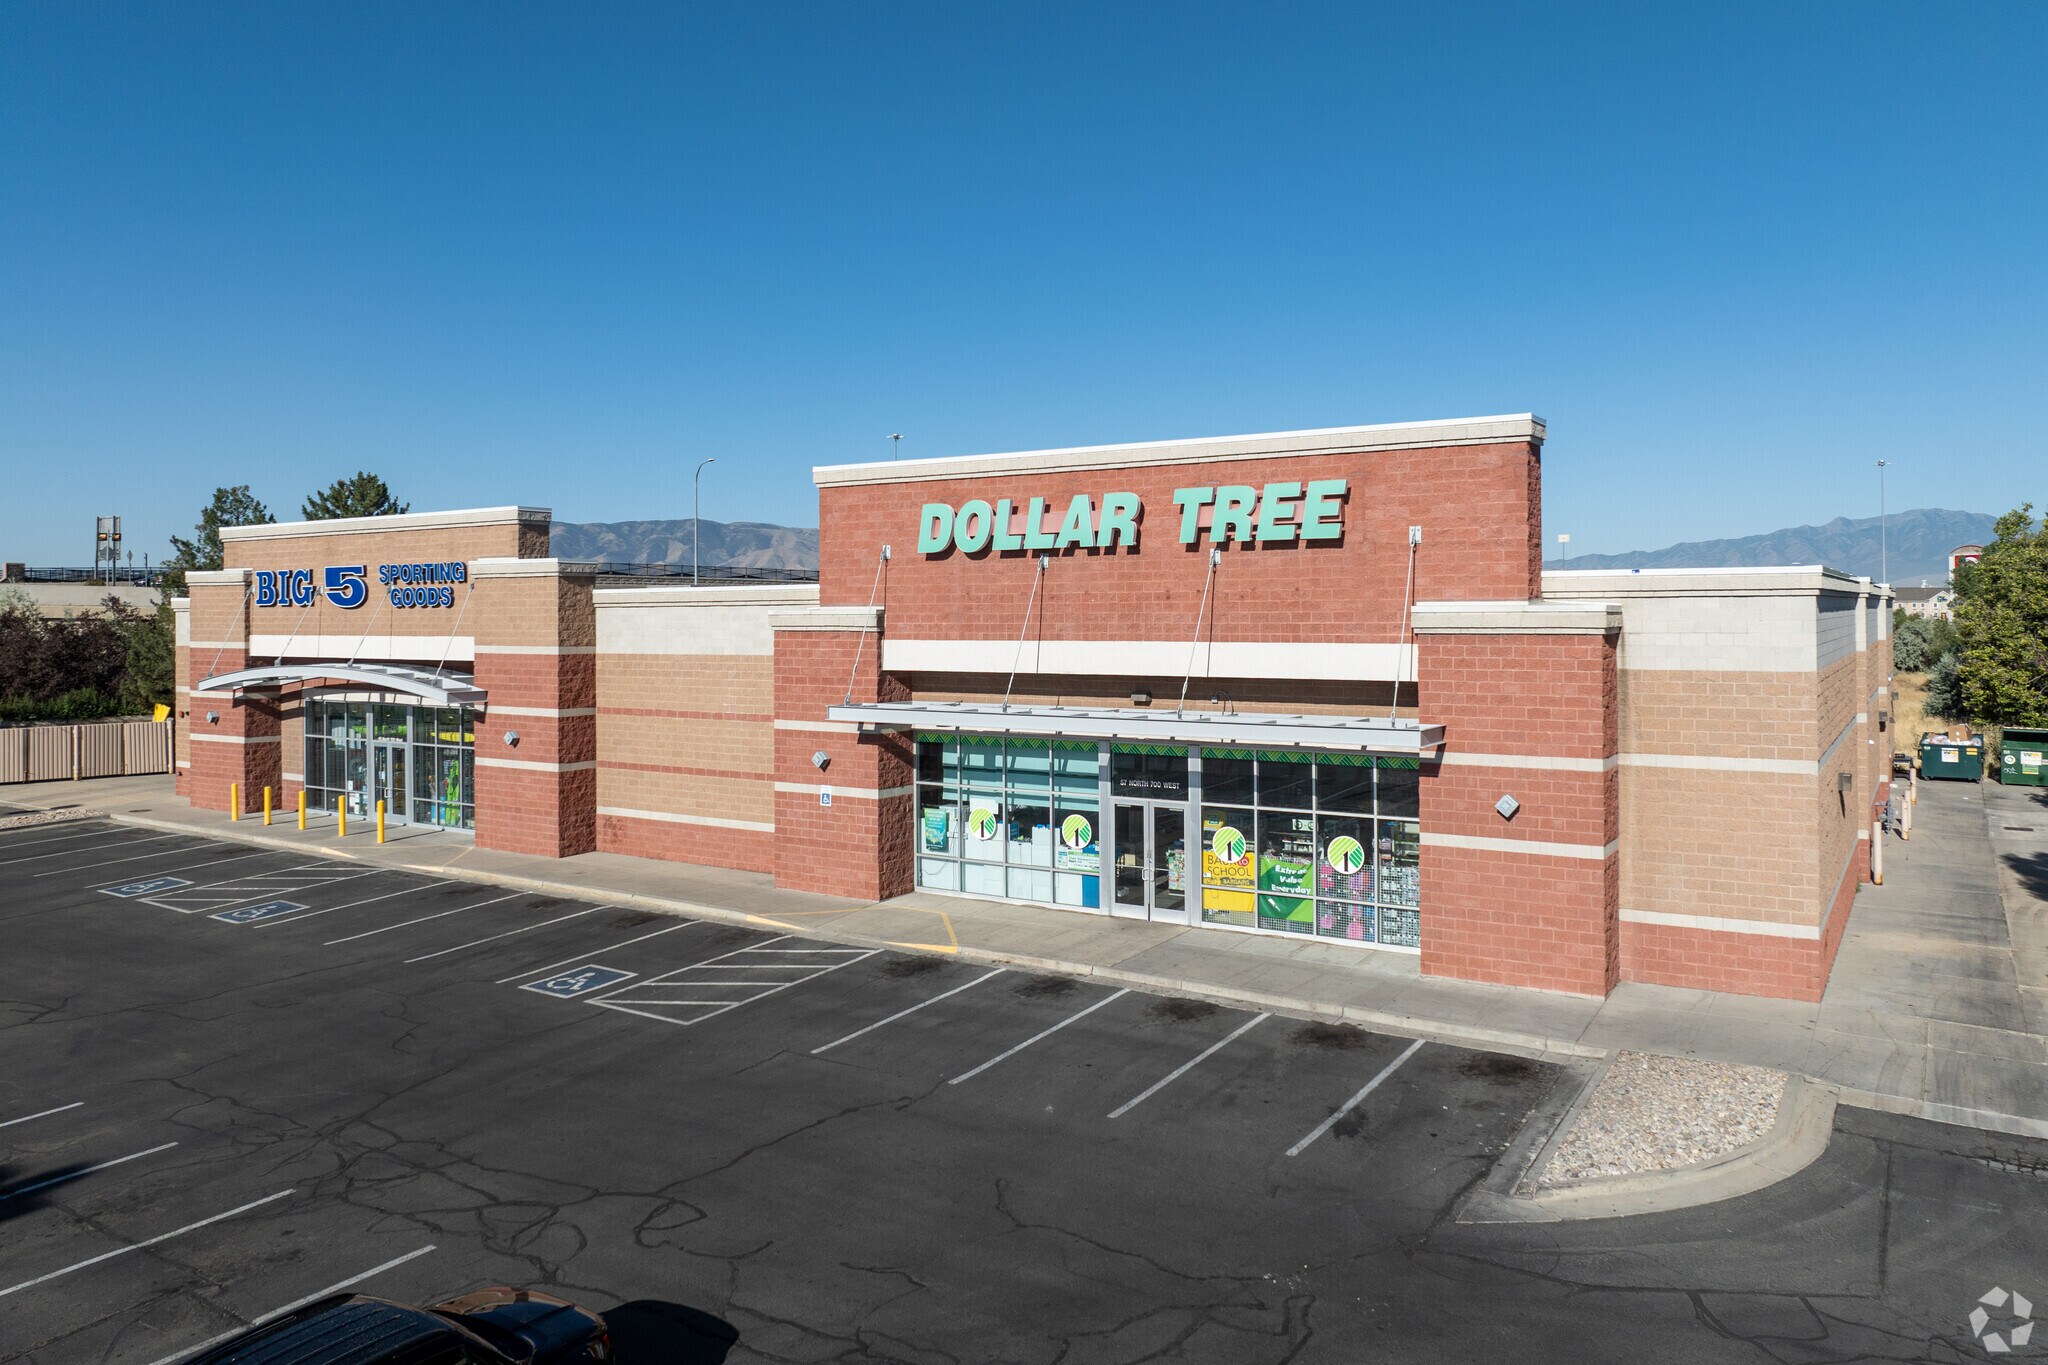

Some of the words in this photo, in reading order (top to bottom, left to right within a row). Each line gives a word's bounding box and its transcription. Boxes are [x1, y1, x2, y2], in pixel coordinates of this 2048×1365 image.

[918, 493, 1141, 554] DOLLAR
[1173, 479, 1348, 544] TREE
[379, 562, 466, 585] SPORTING
[256, 569, 314, 607] BIG
[324, 565, 367, 609] 5
[390, 586, 452, 608] GOODS
[1163, 782, 1180, 790] WEST
[1207, 866, 1252, 877] SCHOOL
